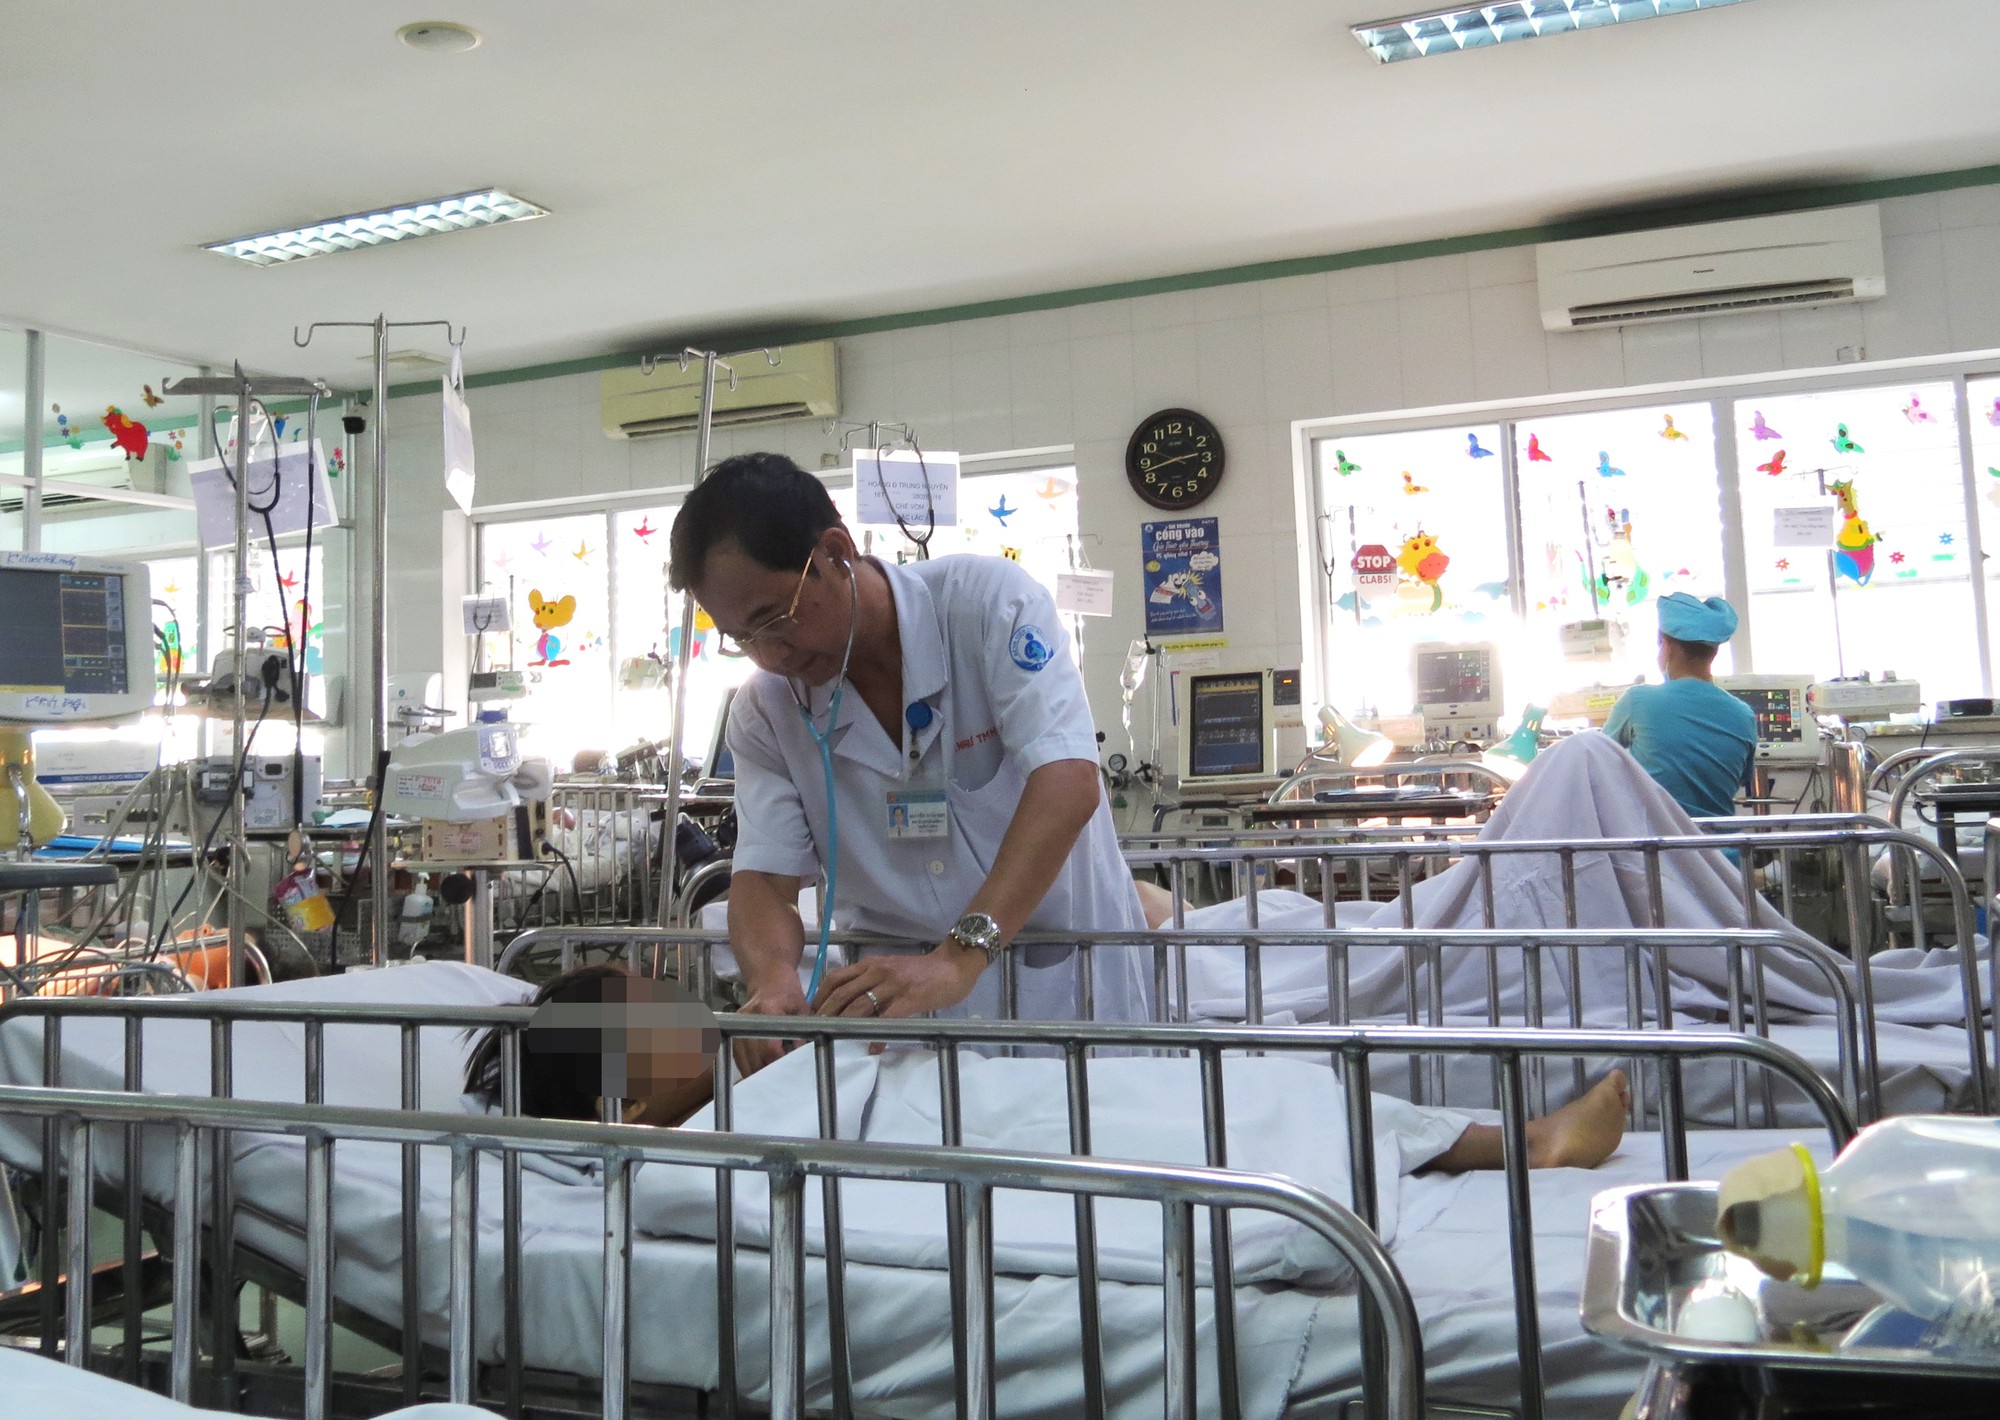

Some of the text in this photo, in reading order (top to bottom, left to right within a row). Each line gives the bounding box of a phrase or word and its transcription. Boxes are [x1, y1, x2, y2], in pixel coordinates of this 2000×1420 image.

[1153, 428, 1164, 440] 11
[1167, 422, 1182, 435] 12
[1187, 425, 1193, 437] 1
[1196, 435, 1206, 447] 2
[1142, 442, 1157, 454] 10
[1140, 457, 1150, 469] 9
[1201, 451, 1212, 463] 3
[1145, 472, 1156, 484] 8
[1197, 466, 1208, 478] 4
[1157, 482, 1168, 494] 7
[1172, 486, 1183, 498] 6
[1187, 480, 1198, 492] 5
[1184, 525, 1205, 539] vào
[1357, 556, 1391, 568] STOP
[1359, 575, 1392, 584] CLABSI
[1266, 667, 1274, 678] 7
